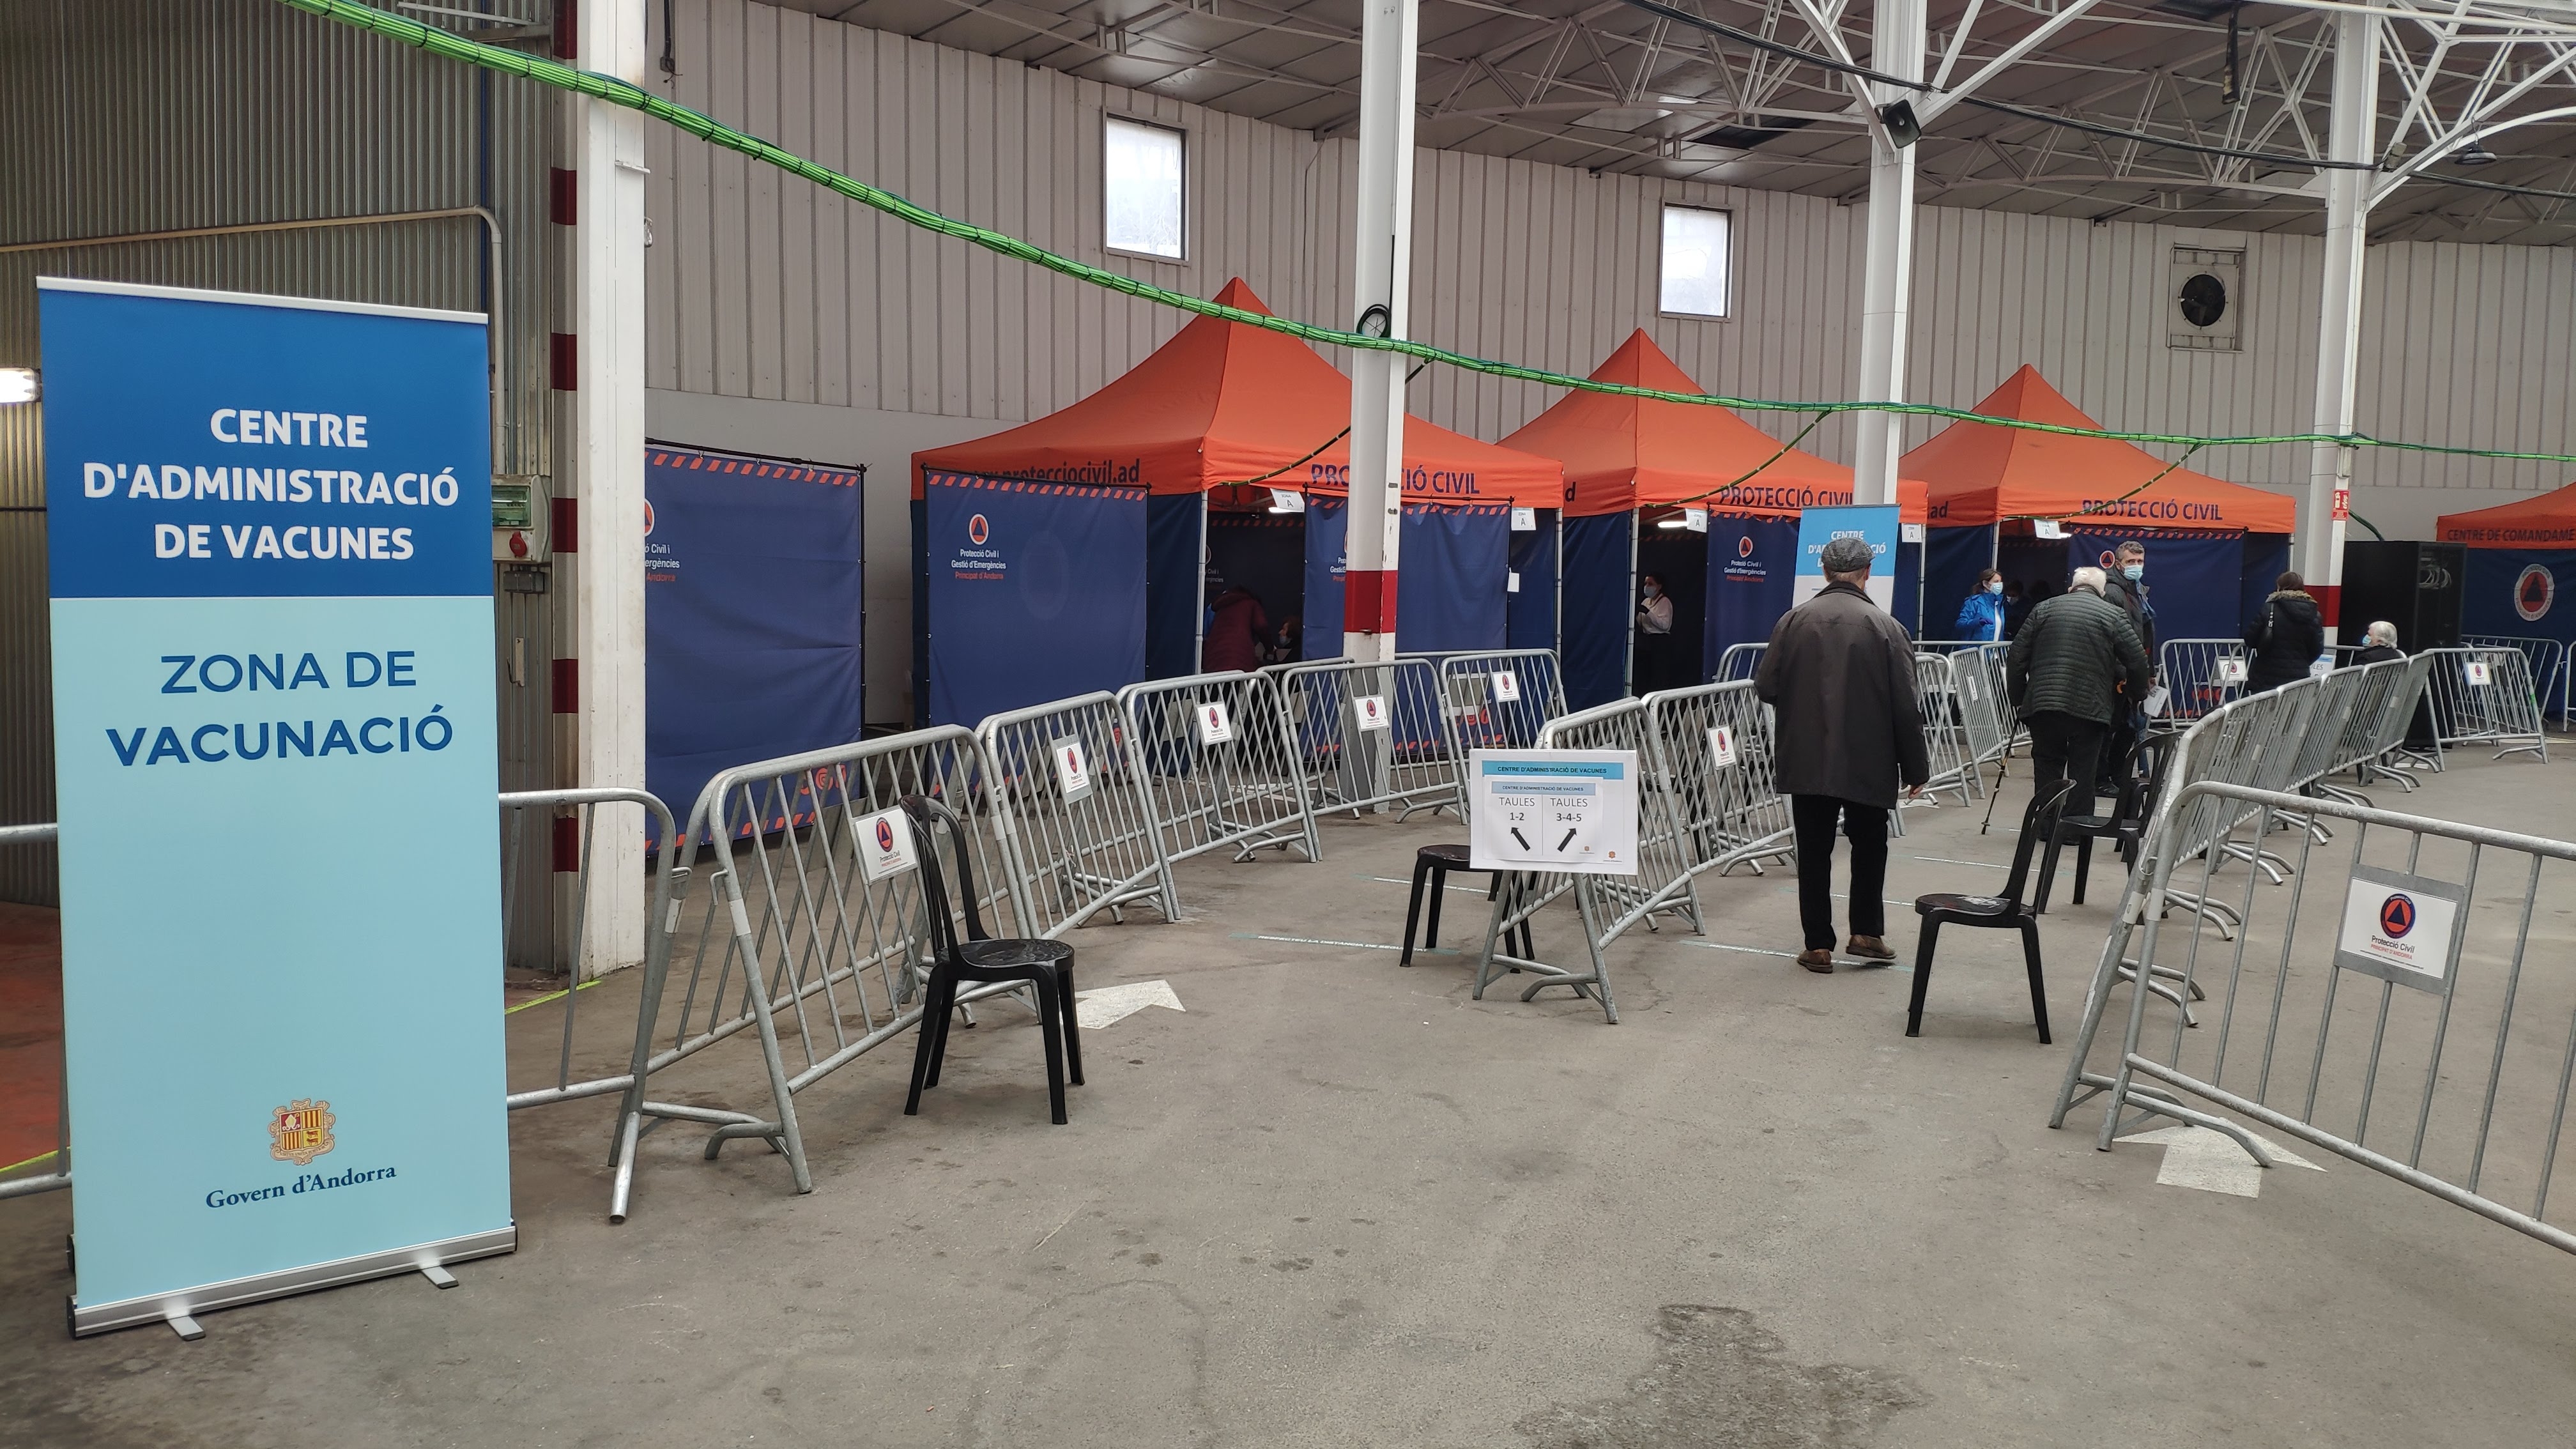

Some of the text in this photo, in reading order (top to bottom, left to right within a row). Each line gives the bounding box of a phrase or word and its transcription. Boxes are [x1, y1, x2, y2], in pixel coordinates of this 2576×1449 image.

[210, 408, 369, 448] CENTRE
[83, 462, 459, 506] D'ADMINISTRACIÓ
[1432, 471, 1480, 494] CIVIL
[1287, 499, 1294, 507] A
[1719, 486, 1814, 507] PROTECCIÓ
[2082, 499, 2223, 521] PROTECCIÓ CIVIL
[1521, 518, 1526, 526] A
[1695, 519, 1700, 527] A
[154, 524, 414, 560] DE VACUNES
[2448, 529, 2484, 541] CENTRE
[2487, 530, 2499, 541] DE
[651, 544, 666, 553] Civil
[960, 549, 984, 557] Protecció
[985, 549, 996, 558] Civil
[645, 558, 680, 569] ergències
[951, 560, 969, 568] Gestió
[160, 650, 417, 694] ZONA DE
[105, 703, 454, 767] VACUNACIÓ
[1499, 797, 1588, 808] TAULES TAULES
[1510, 812, 1582, 822] 1-2 3-4-5
[2372, 935, 2415, 953] Protecció Civil
[206, 1167, 397, 1208] Govern d'Andorra
